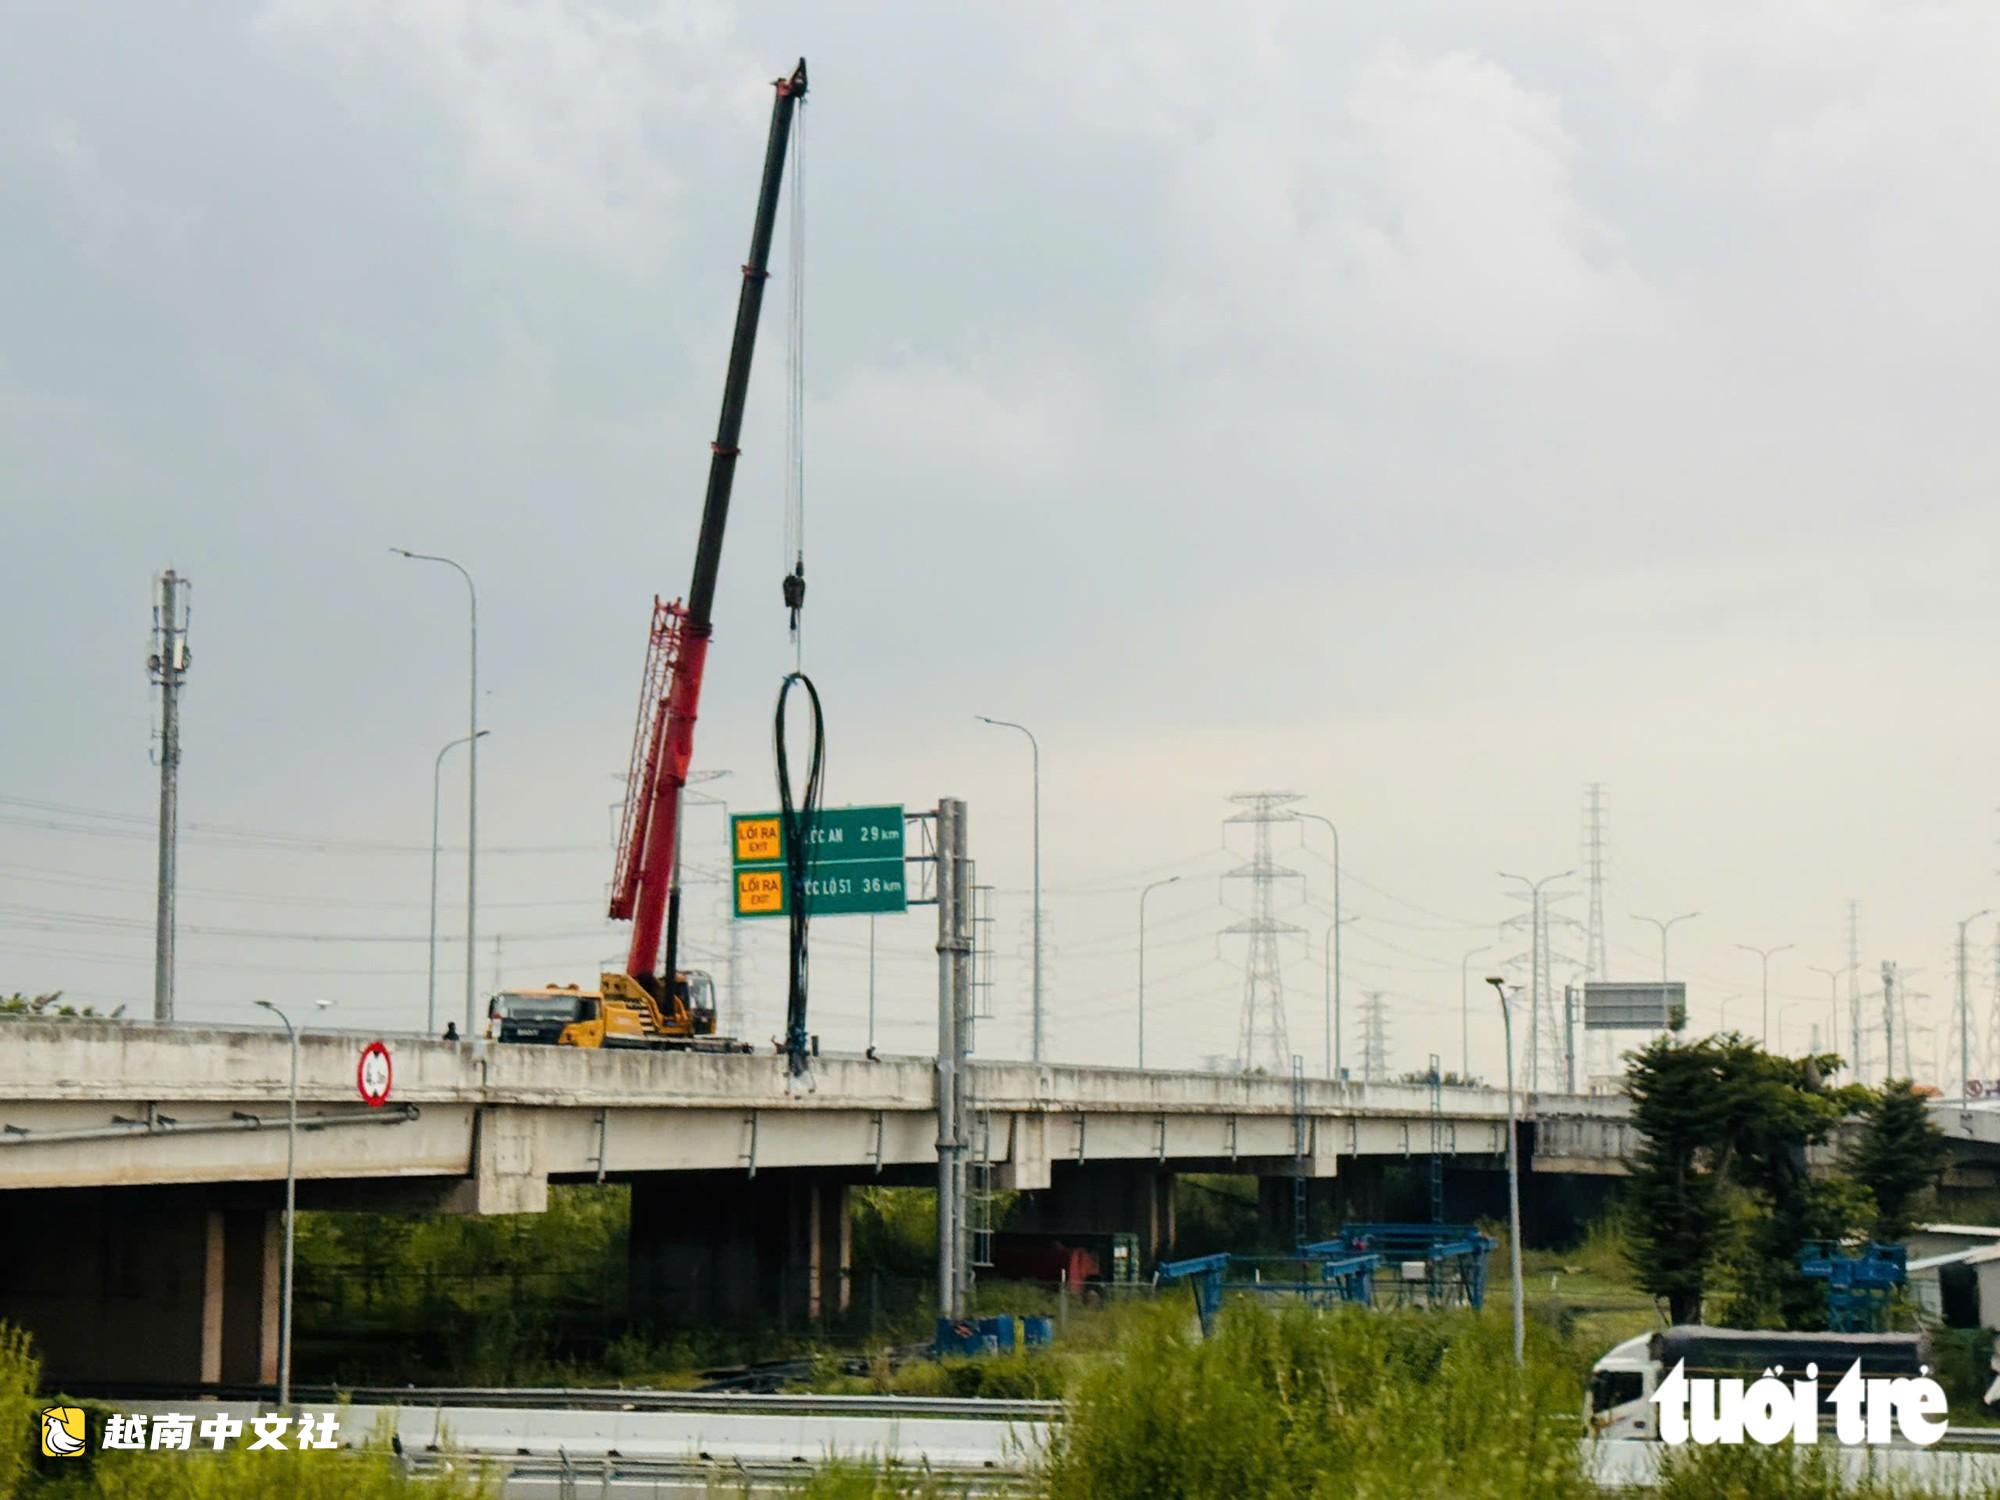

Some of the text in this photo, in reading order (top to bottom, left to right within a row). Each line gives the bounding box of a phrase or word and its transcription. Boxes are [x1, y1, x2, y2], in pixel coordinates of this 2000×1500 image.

[761, 826, 776, 839] RA
[828, 828, 843, 842] AN
[861, 826, 879, 841] 29
[881, 828, 899, 840] km
[749, 842, 768, 852] EXIT
[762, 879, 779, 891] RA
[863, 878, 880, 893] 36
[883, 881, 901, 892] km
